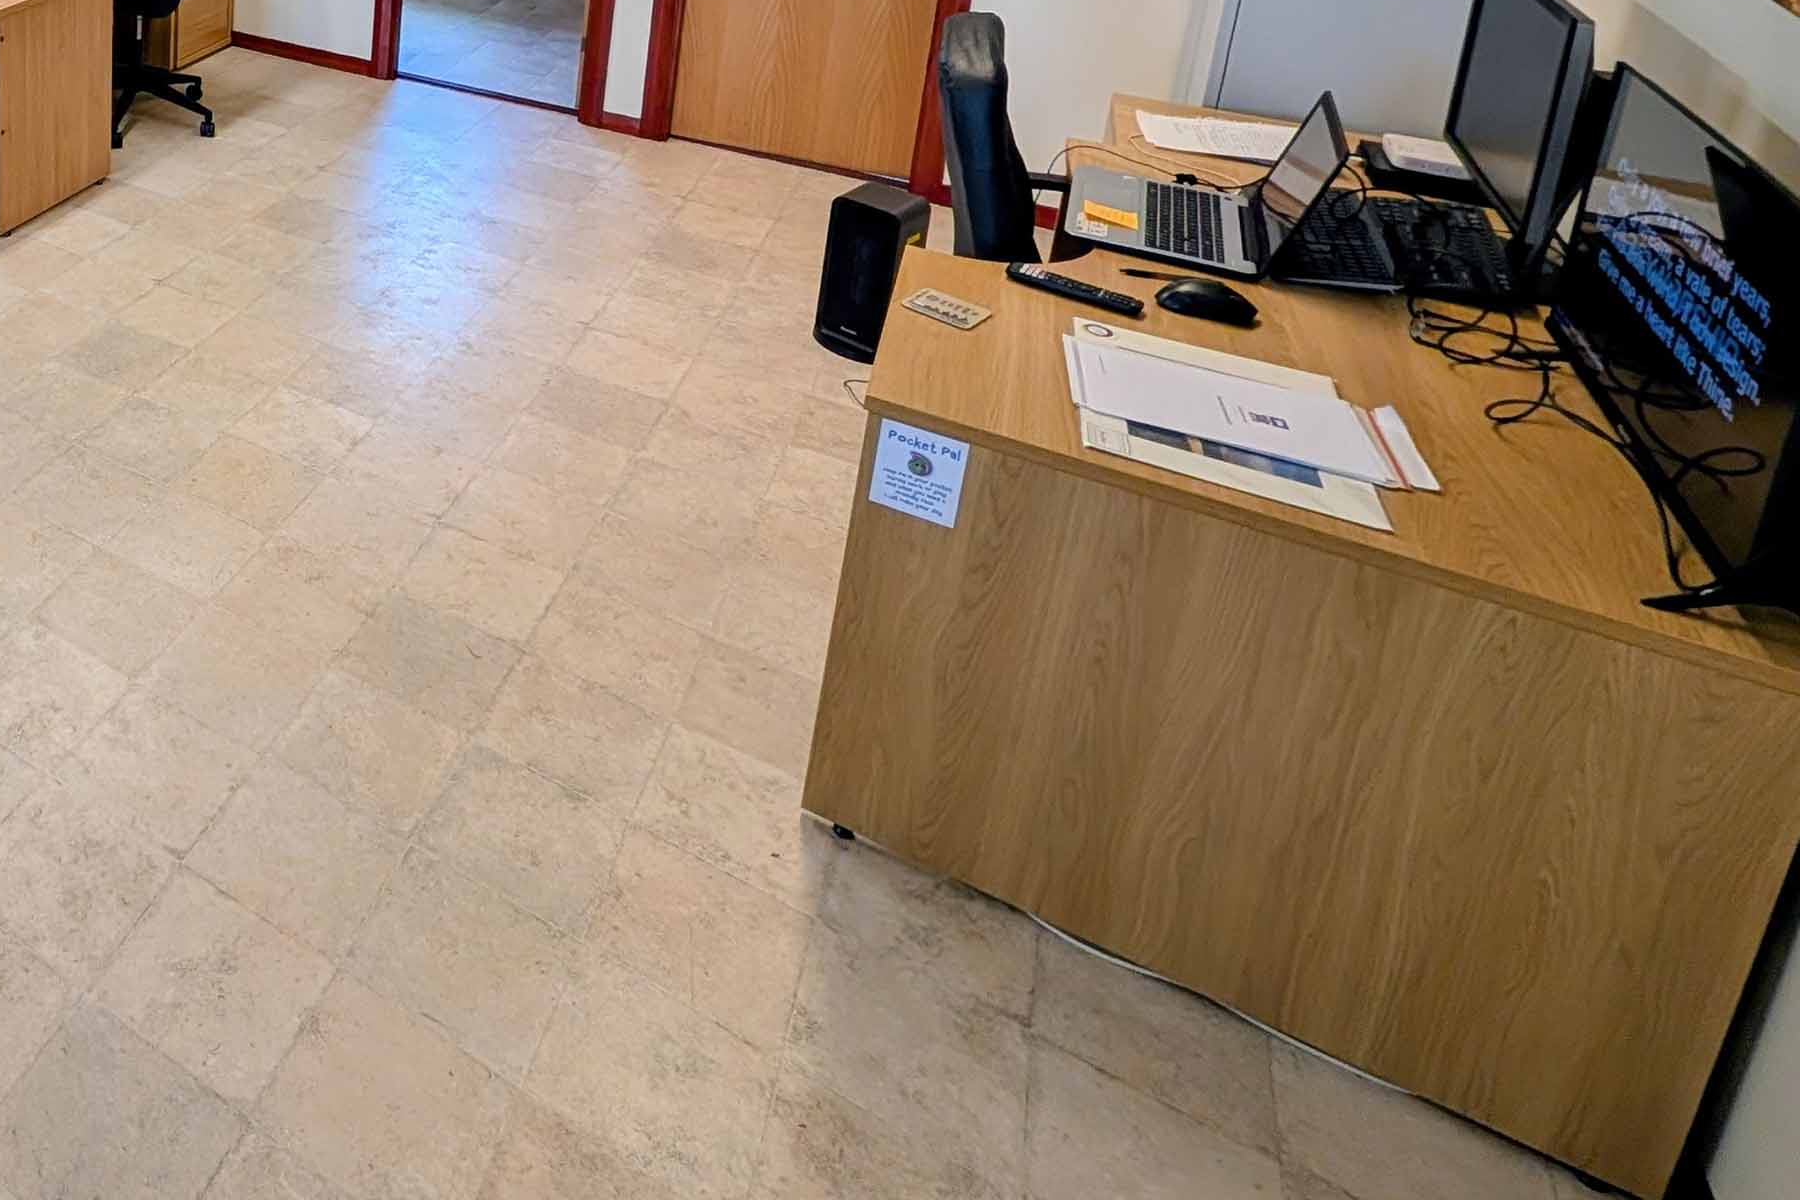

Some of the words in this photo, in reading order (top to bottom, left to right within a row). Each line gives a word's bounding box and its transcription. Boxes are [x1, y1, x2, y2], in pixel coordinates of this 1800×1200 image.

[1686, 266, 1713, 305] vale
[1711, 295, 1729, 320] of
[1731, 272, 1771, 329] years,
[887, 429, 938, 455] Pocket
[940, 445, 963, 462] Pal
